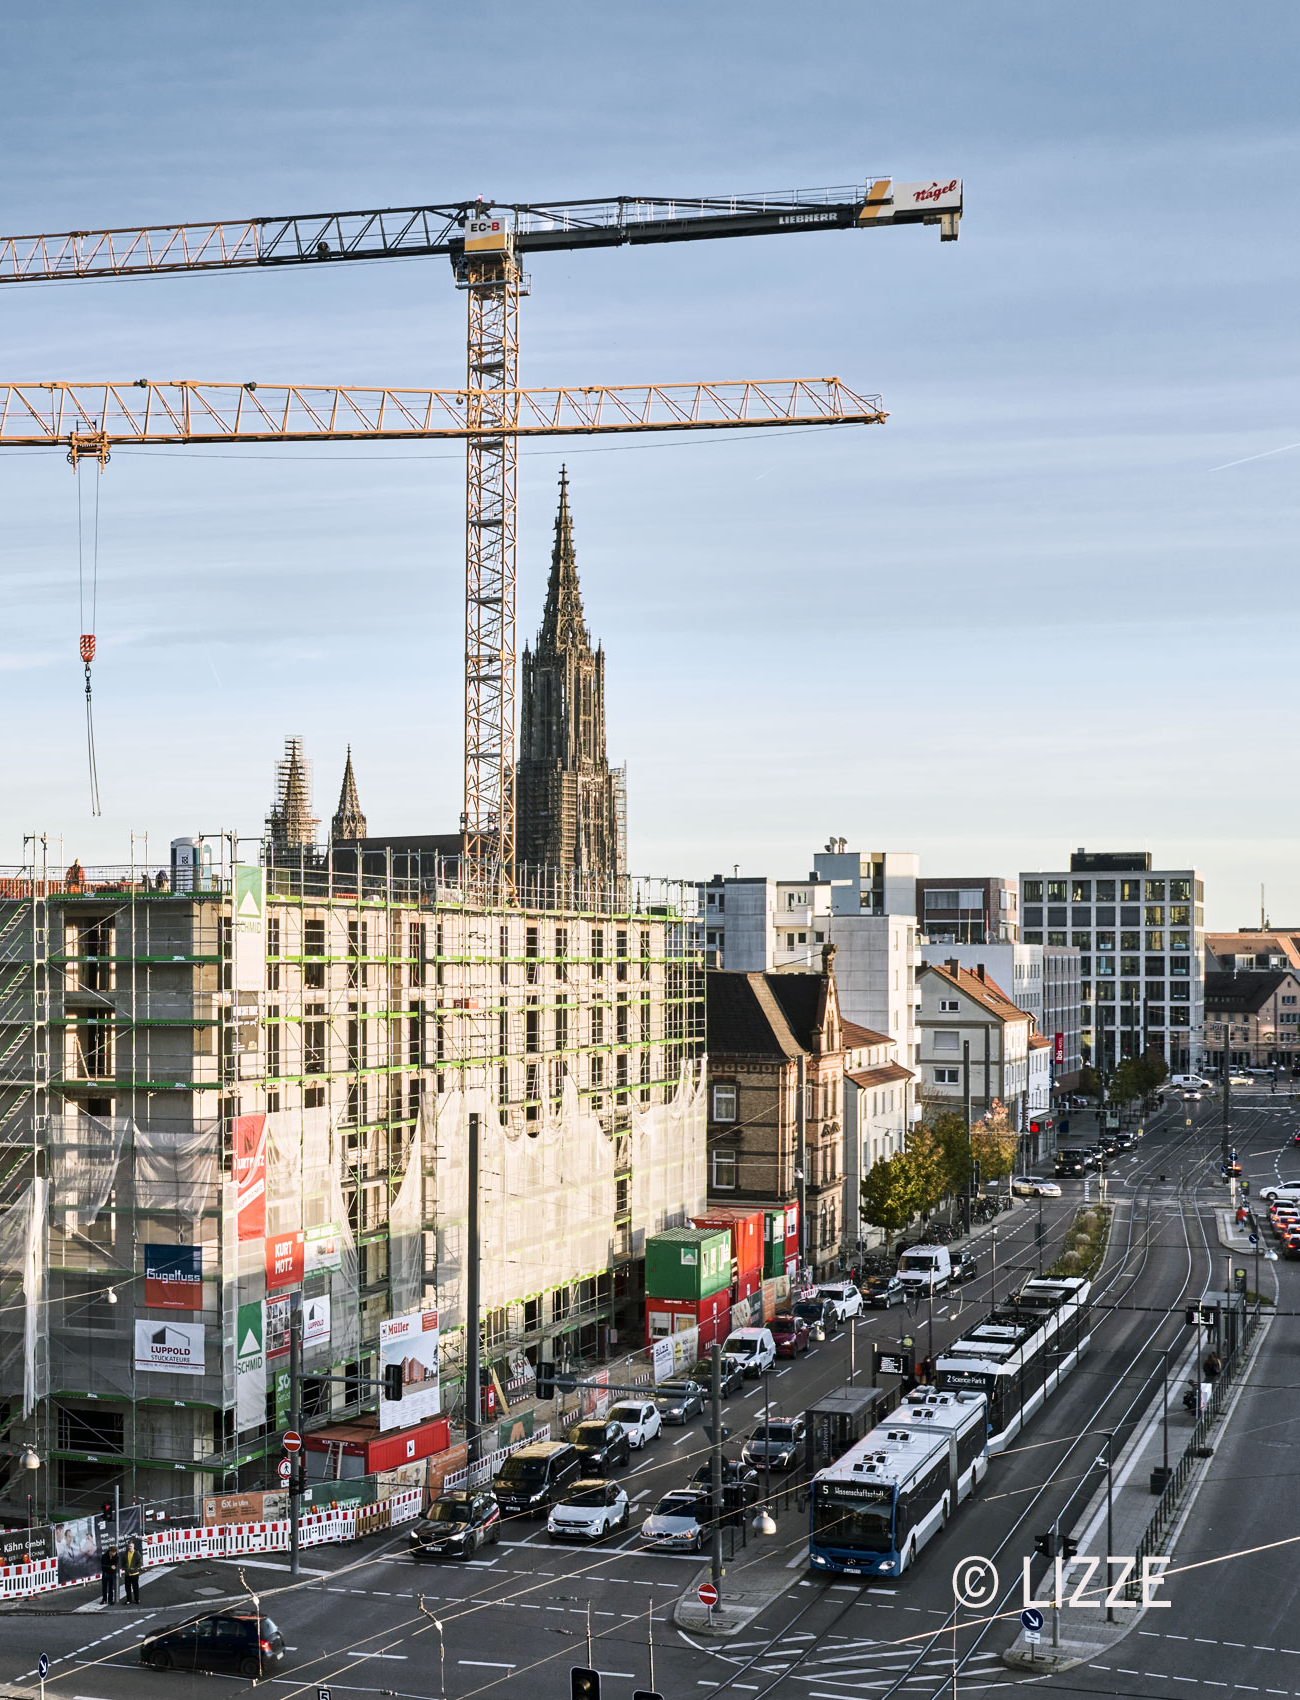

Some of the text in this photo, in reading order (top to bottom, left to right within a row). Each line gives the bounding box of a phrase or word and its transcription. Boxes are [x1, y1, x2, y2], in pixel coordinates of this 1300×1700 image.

[913, 180, 957, 201] Nagel
[778, 212, 838, 225] LIEBHERR
[470, 221, 500, 232] EC-B
[234, 1157, 250, 1170] URT
[275, 1240, 293, 1258] KURT
[275, 1257, 293, 1274] MOTZ
[146, 1268, 201, 1284] Gugelfuss
[388, 1322, 409, 1336] Müller
[151, 1346, 191, 1356] LUPPOLD
[238, 1357, 263, 1375] SCHMID
[277, 1374, 291, 1392] SO
[947, 1375, 951, 1383] 2
[823, 1485, 829, 1495] 5
[3, 1542, 23, 1553] Kähn
[24, 1538, 46, 1549] GmbH
